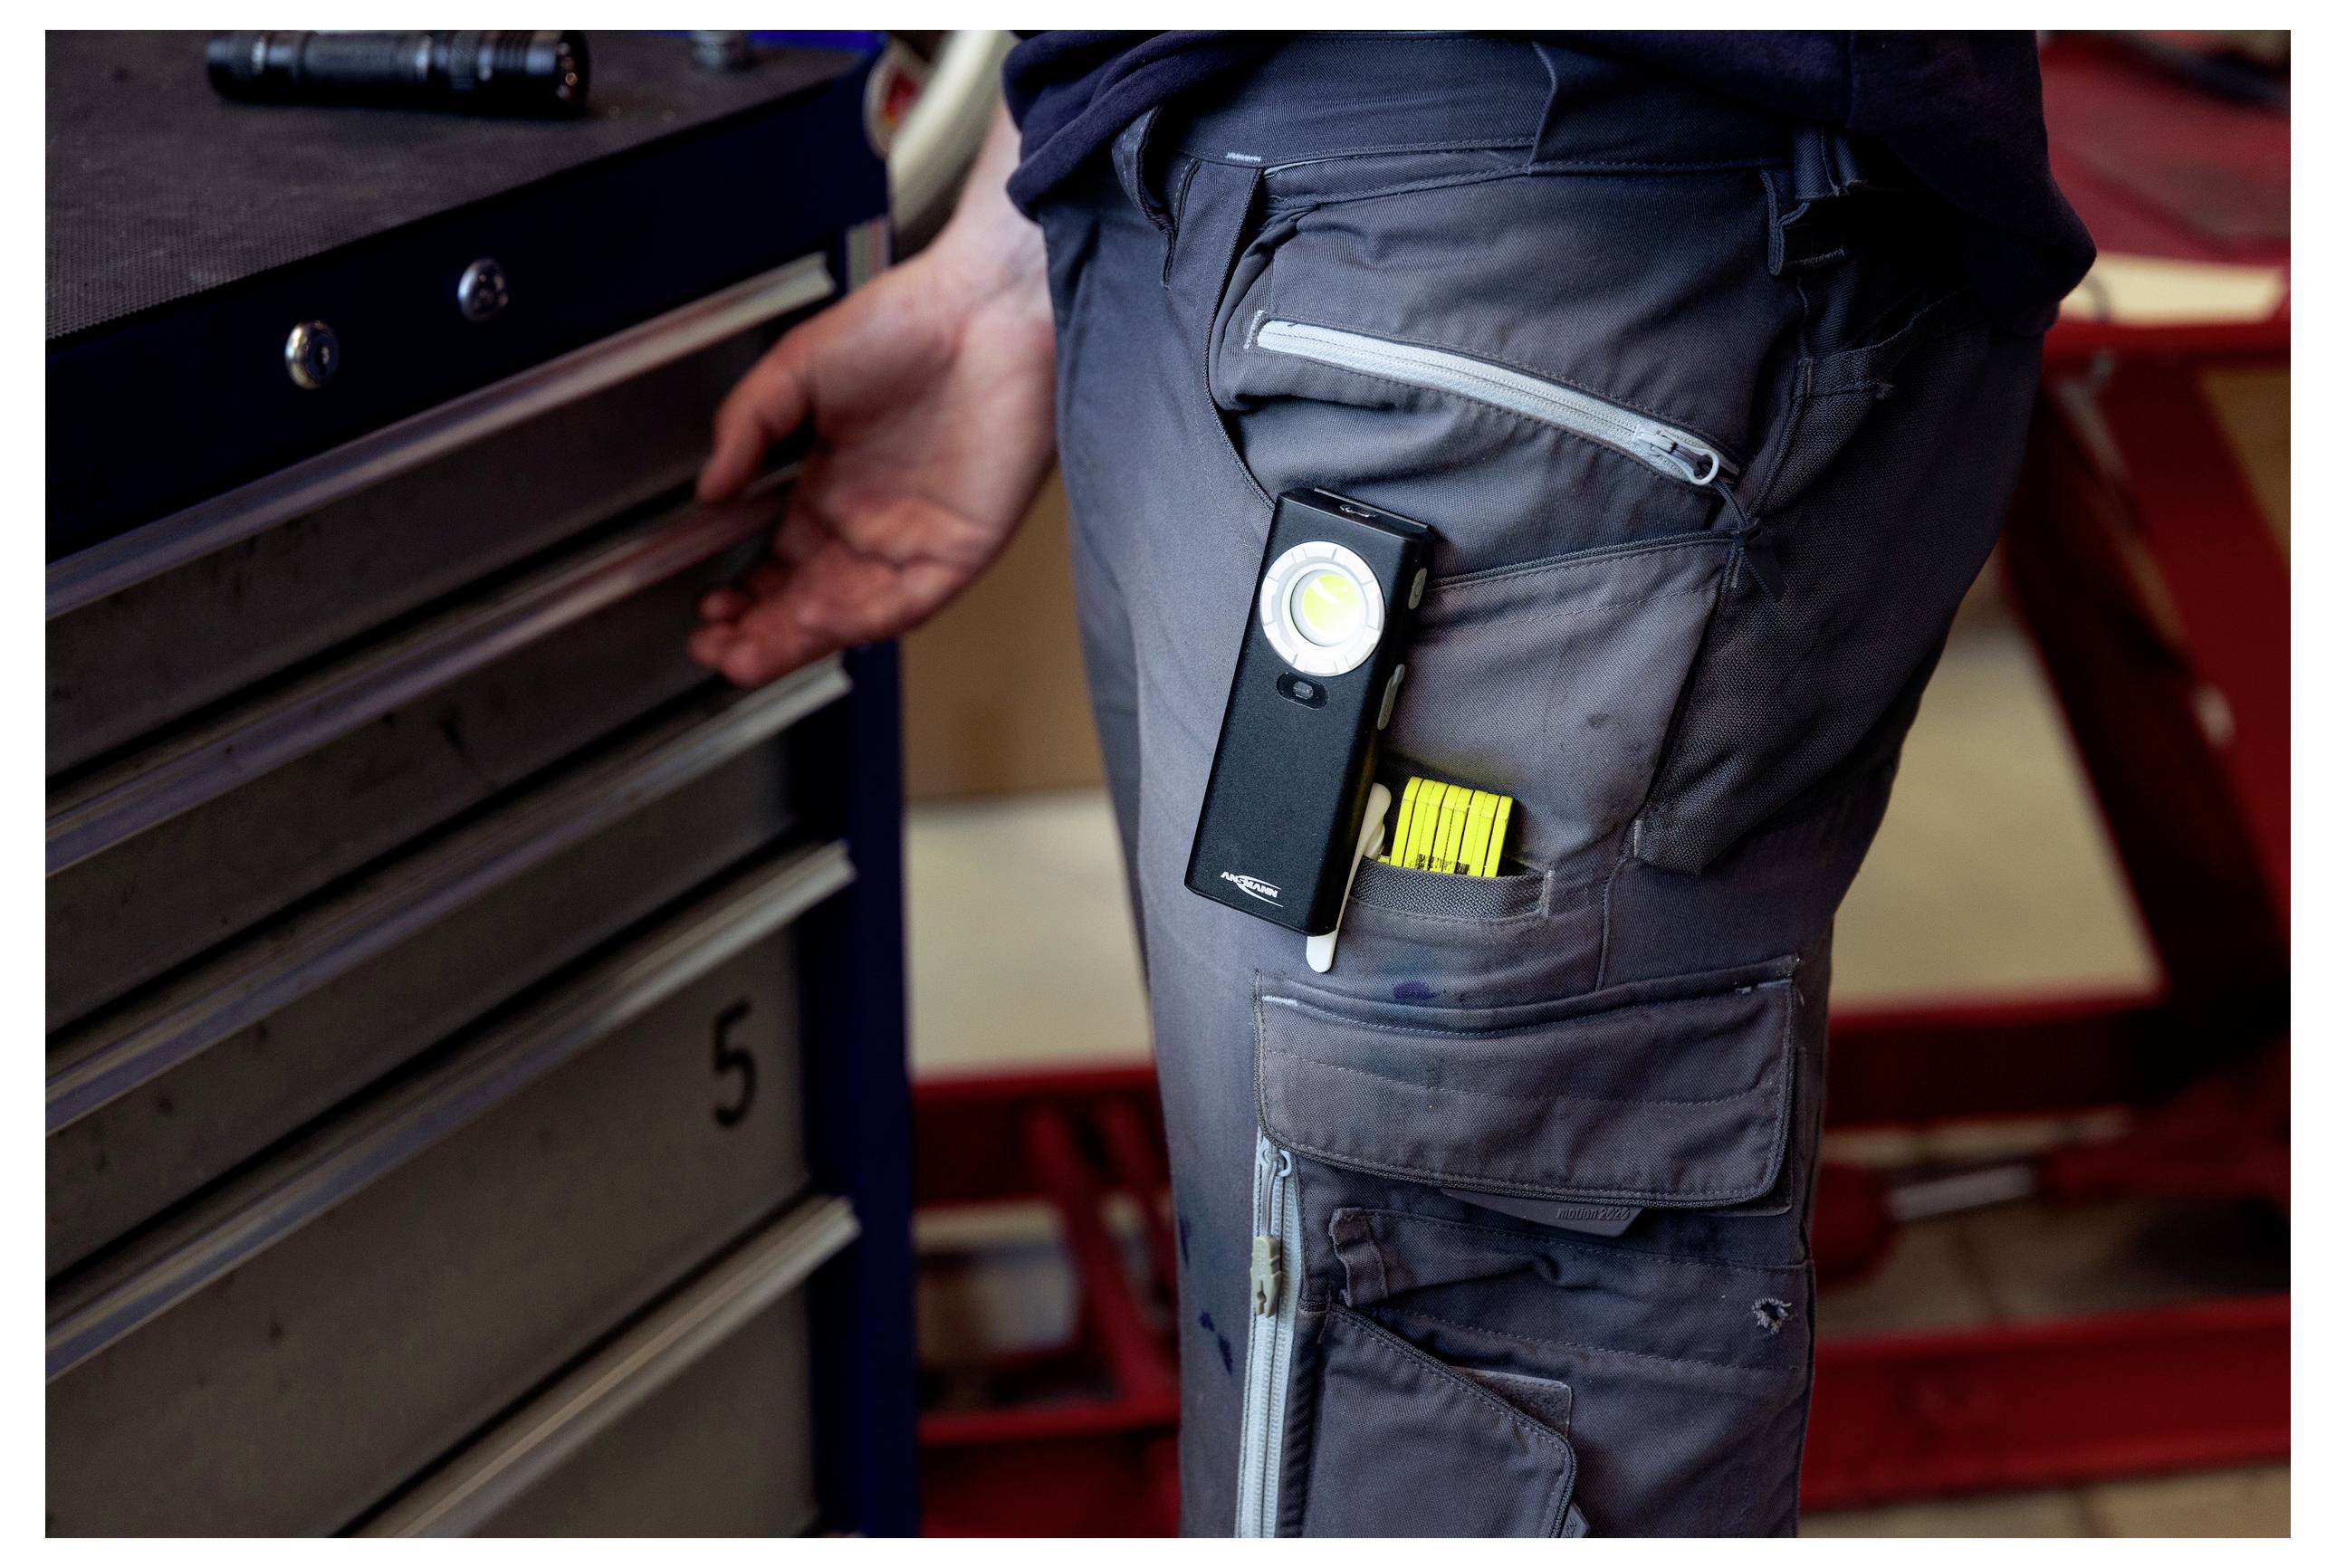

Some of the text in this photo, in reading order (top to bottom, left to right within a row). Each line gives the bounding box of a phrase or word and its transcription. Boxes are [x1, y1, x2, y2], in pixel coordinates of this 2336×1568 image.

[1220, 871, 1278, 898] ANSMANN
[714, 999, 757, 1125] 5
[1557, 1206, 1630, 1220] motion 2020
